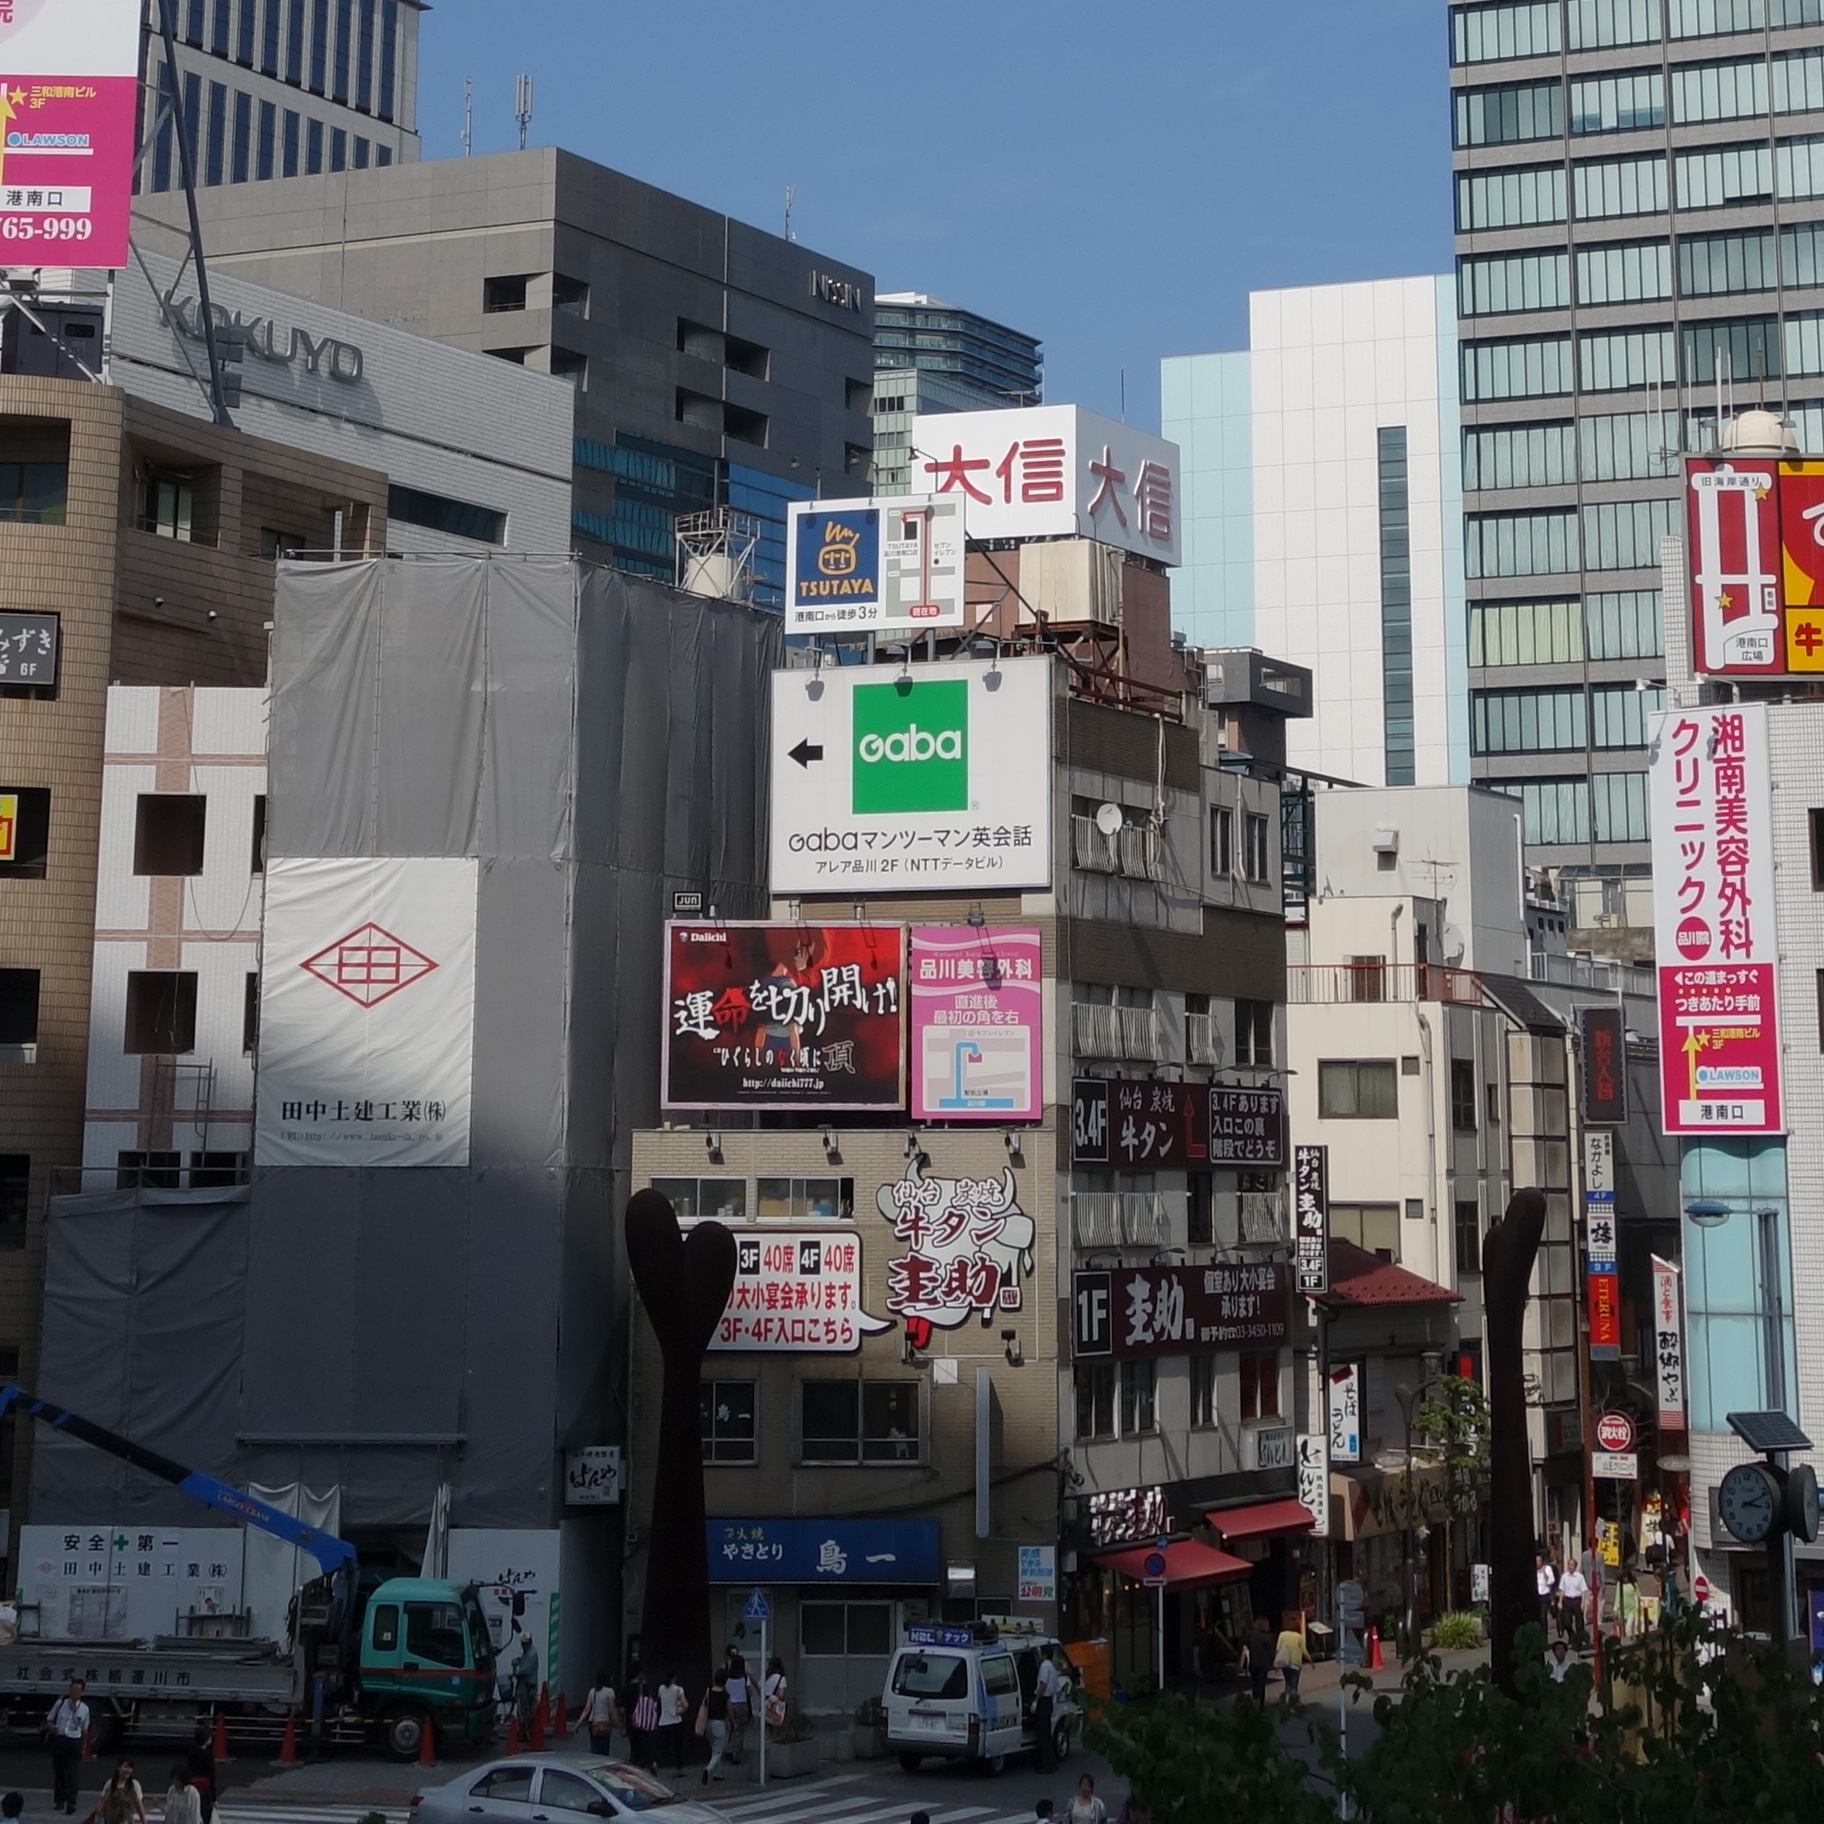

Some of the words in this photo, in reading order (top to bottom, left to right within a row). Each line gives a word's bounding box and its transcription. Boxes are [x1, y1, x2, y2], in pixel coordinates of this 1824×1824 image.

[30, 86, 97, 98] 三和港南ビル
[30, 98, 46, 109] 3F
[23, 133, 89, 146] LAWSON
[7, 190, 63, 206] 港南口
[160, 288, 364, 380] KOKUYO
[924, 438, 1066, 505] 大信
[1088, 444, 1171, 540] 大信
[800, 579, 874, 597] TSUTAYA
[1736, 637, 1769, 648] 港南口
[1742, 650, 1764, 661] 広場
[20, 663, 37, 676] 6F
[1672, 719, 1705, 914] クリニック
[789, 825, 1032, 853] Gabaマンツーマン英会話
[1712, 714, 1753, 959] 湘南美容外科
[1678, 930, 1710, 946] 品川院
[920, 958, 1032, 980] 品川美容外科
[1684, 970, 1759, 986] この道まっすぐ
[954, 995, 998, 1009] 直進後
[1675, 995, 1761, 1012] つきあたり手前
[933, 1010, 1019, 1024] 最初の角を右
[1713, 1039, 1725, 1049] 3F
[1709, 1069, 1759, 1081] LAWSON
[1119, 1086, 1143, 1110] 仙台
[1150, 1086, 1176, 1113] 炭焼
[1075, 1098, 1107, 1147] 3.4F
[1701, 1105, 1744, 1120] 港南口
[1212, 1116, 1265, 1136] 入口この裏
[1120, 1115, 1174, 1162] 牛タン
[1212, 1139, 1276, 1160] 階段でどうぞ
[1297, 1148, 1311, 1191] 牛タン
[1590, 1137, 1603, 1190] なかよし
[893, 1179, 941, 1207] 仙台
[1298, 1193, 1323, 1229] 圭助
[895, 1205, 1006, 1250] 牛タン
[740, 1247, 759, 1268] 3F
[764, 1243, 795, 1272] 40席
[801, 1247, 820, 1268] 4F
[825, 1243, 855, 1273] 40席
[1300, 1258, 1322, 1272] 3.4F
[886, 1252, 1002, 1311] 圭助
[1204, 1269, 1276, 1294] 個室あり大小宴会
[1303, 1276, 1319, 1287] 1F
[1078, 1289, 1108, 1342] 1F
[1125, 1273, 1185, 1346] 圭助
[1221, 1295, 1261, 1319] 承ります!
[721, 1318, 854, 1345] 3F・4F入口こちら
[1600, 1425, 1628, 1440] 消火栓
[64, 1534, 106, 1552] 安全
[137, 1534, 179, 1552] 第一
[722, 1542, 784, 1561] やきとり
